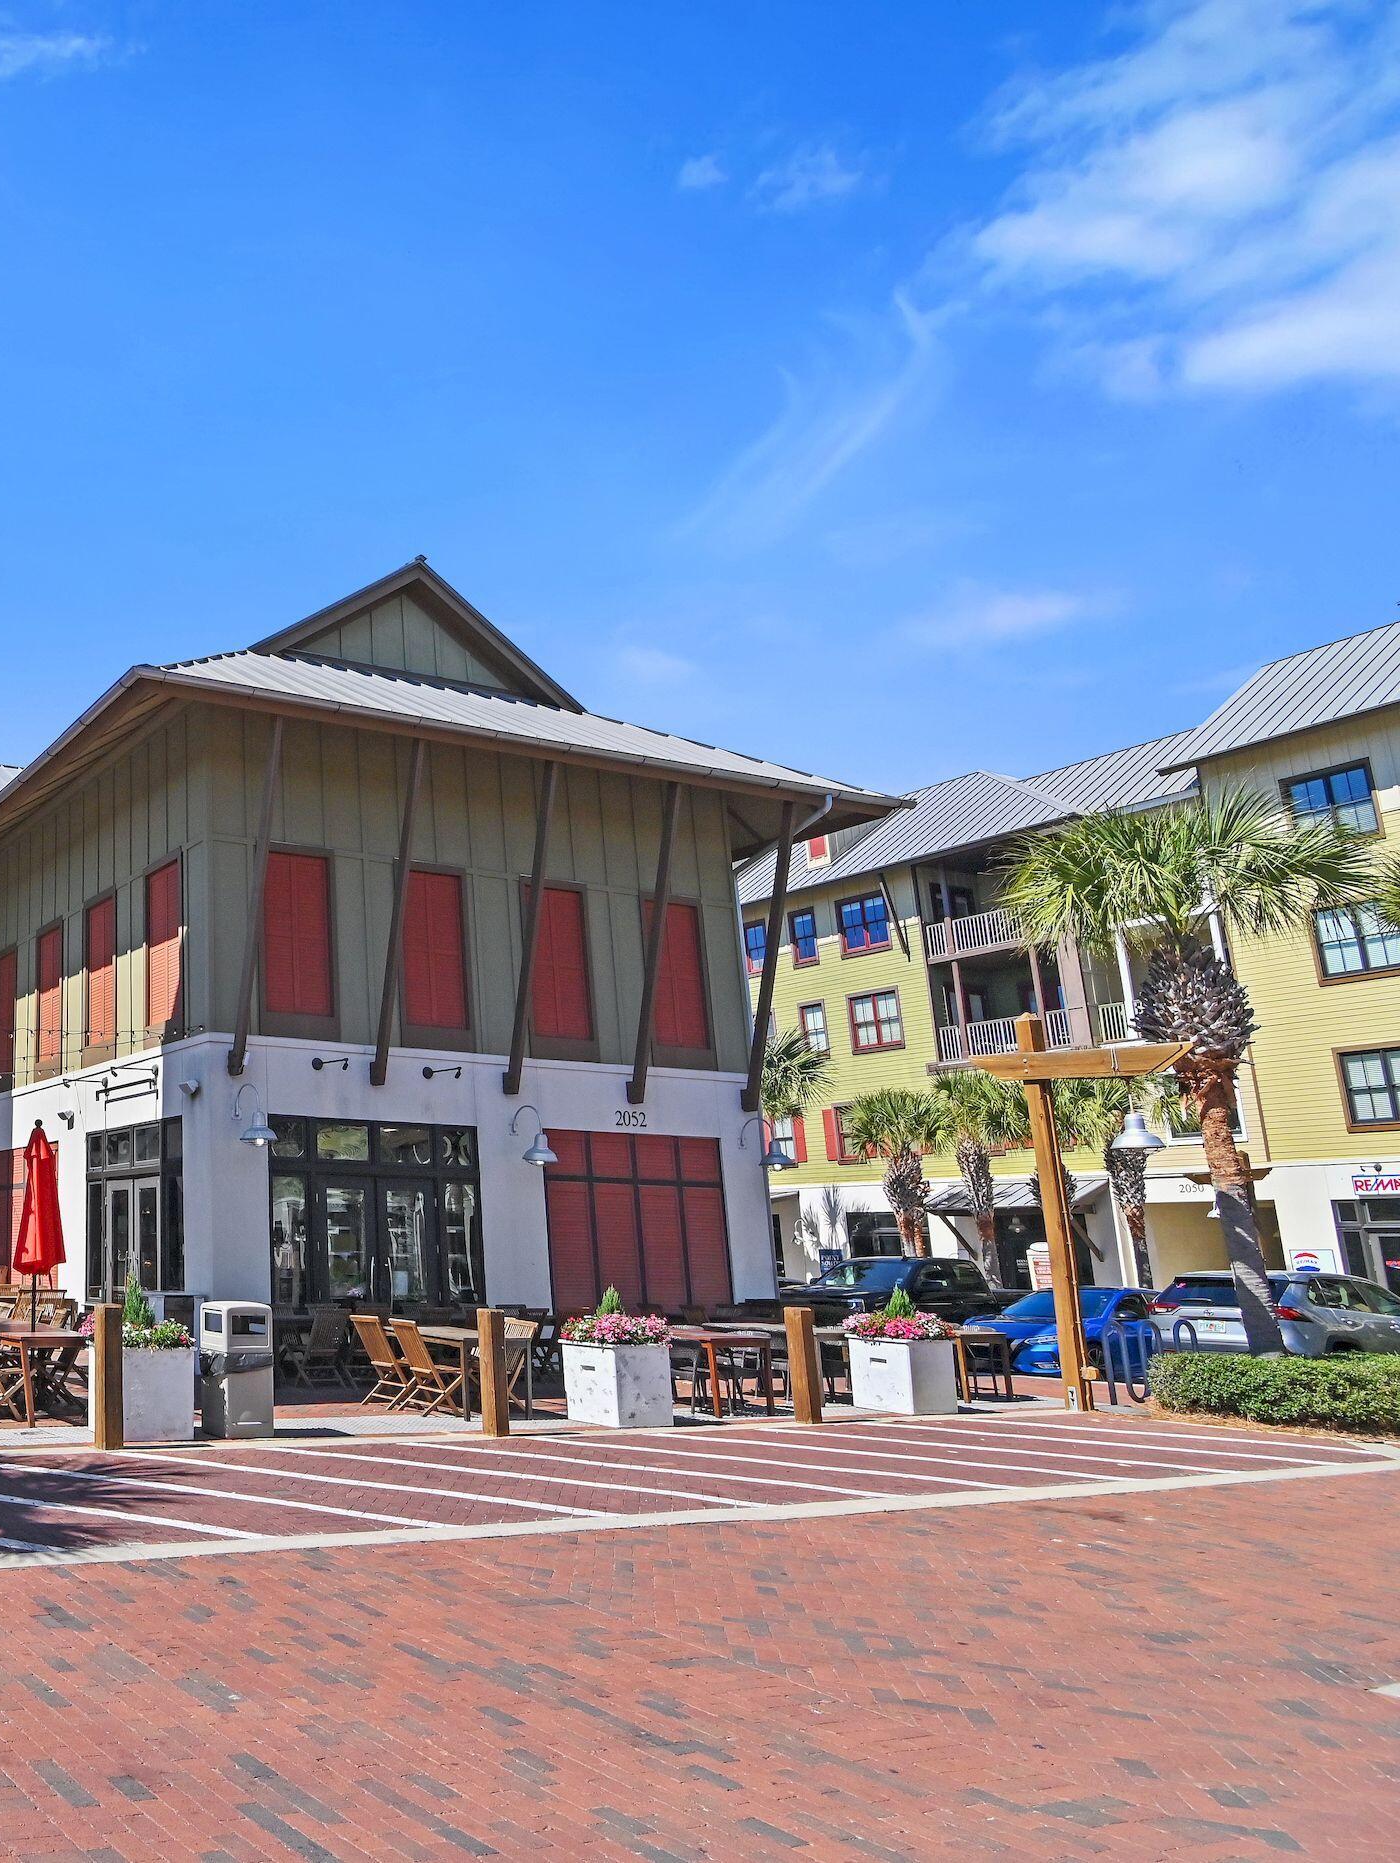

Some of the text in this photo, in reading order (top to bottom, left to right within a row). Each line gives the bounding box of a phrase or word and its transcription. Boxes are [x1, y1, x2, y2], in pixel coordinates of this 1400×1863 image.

[615, 1110, 647, 1127] 2052
[1179, 1183, 1204, 1193] 2050
[1354, 1178, 1400, 1191] RE/MA
